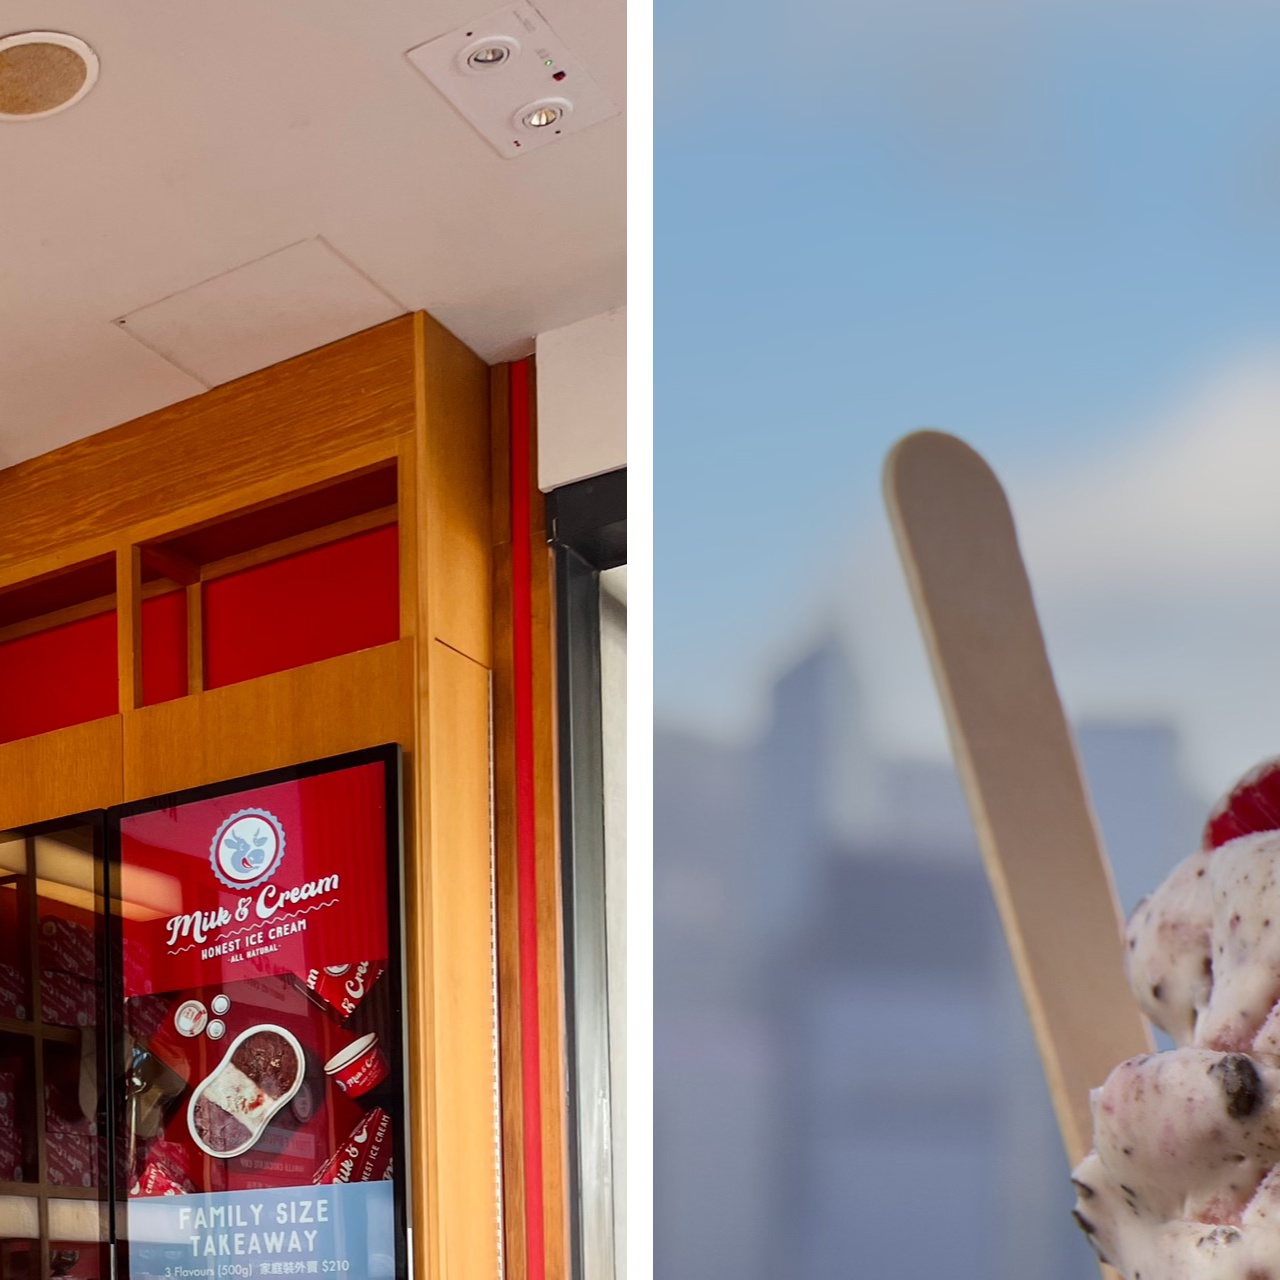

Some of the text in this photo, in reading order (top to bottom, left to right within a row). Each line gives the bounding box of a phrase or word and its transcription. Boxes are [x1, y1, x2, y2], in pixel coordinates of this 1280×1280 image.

[166, 874, 339, 946] Milk & Cream
[202, 919, 306, 960] HONEST ICE CREAM
[375, 1115, 390, 1144] CREAM
[179, 1199, 328, 1230] FAMILY SIZE
[190, 1230, 318, 1256] TAKEAWAY
[165, 1267, 170, 1278] 3
[174, 1265, 214, 1277] Flavours
[218, 1263, 252, 1277] (500g)
[322, 1260, 349, 1273] $210
